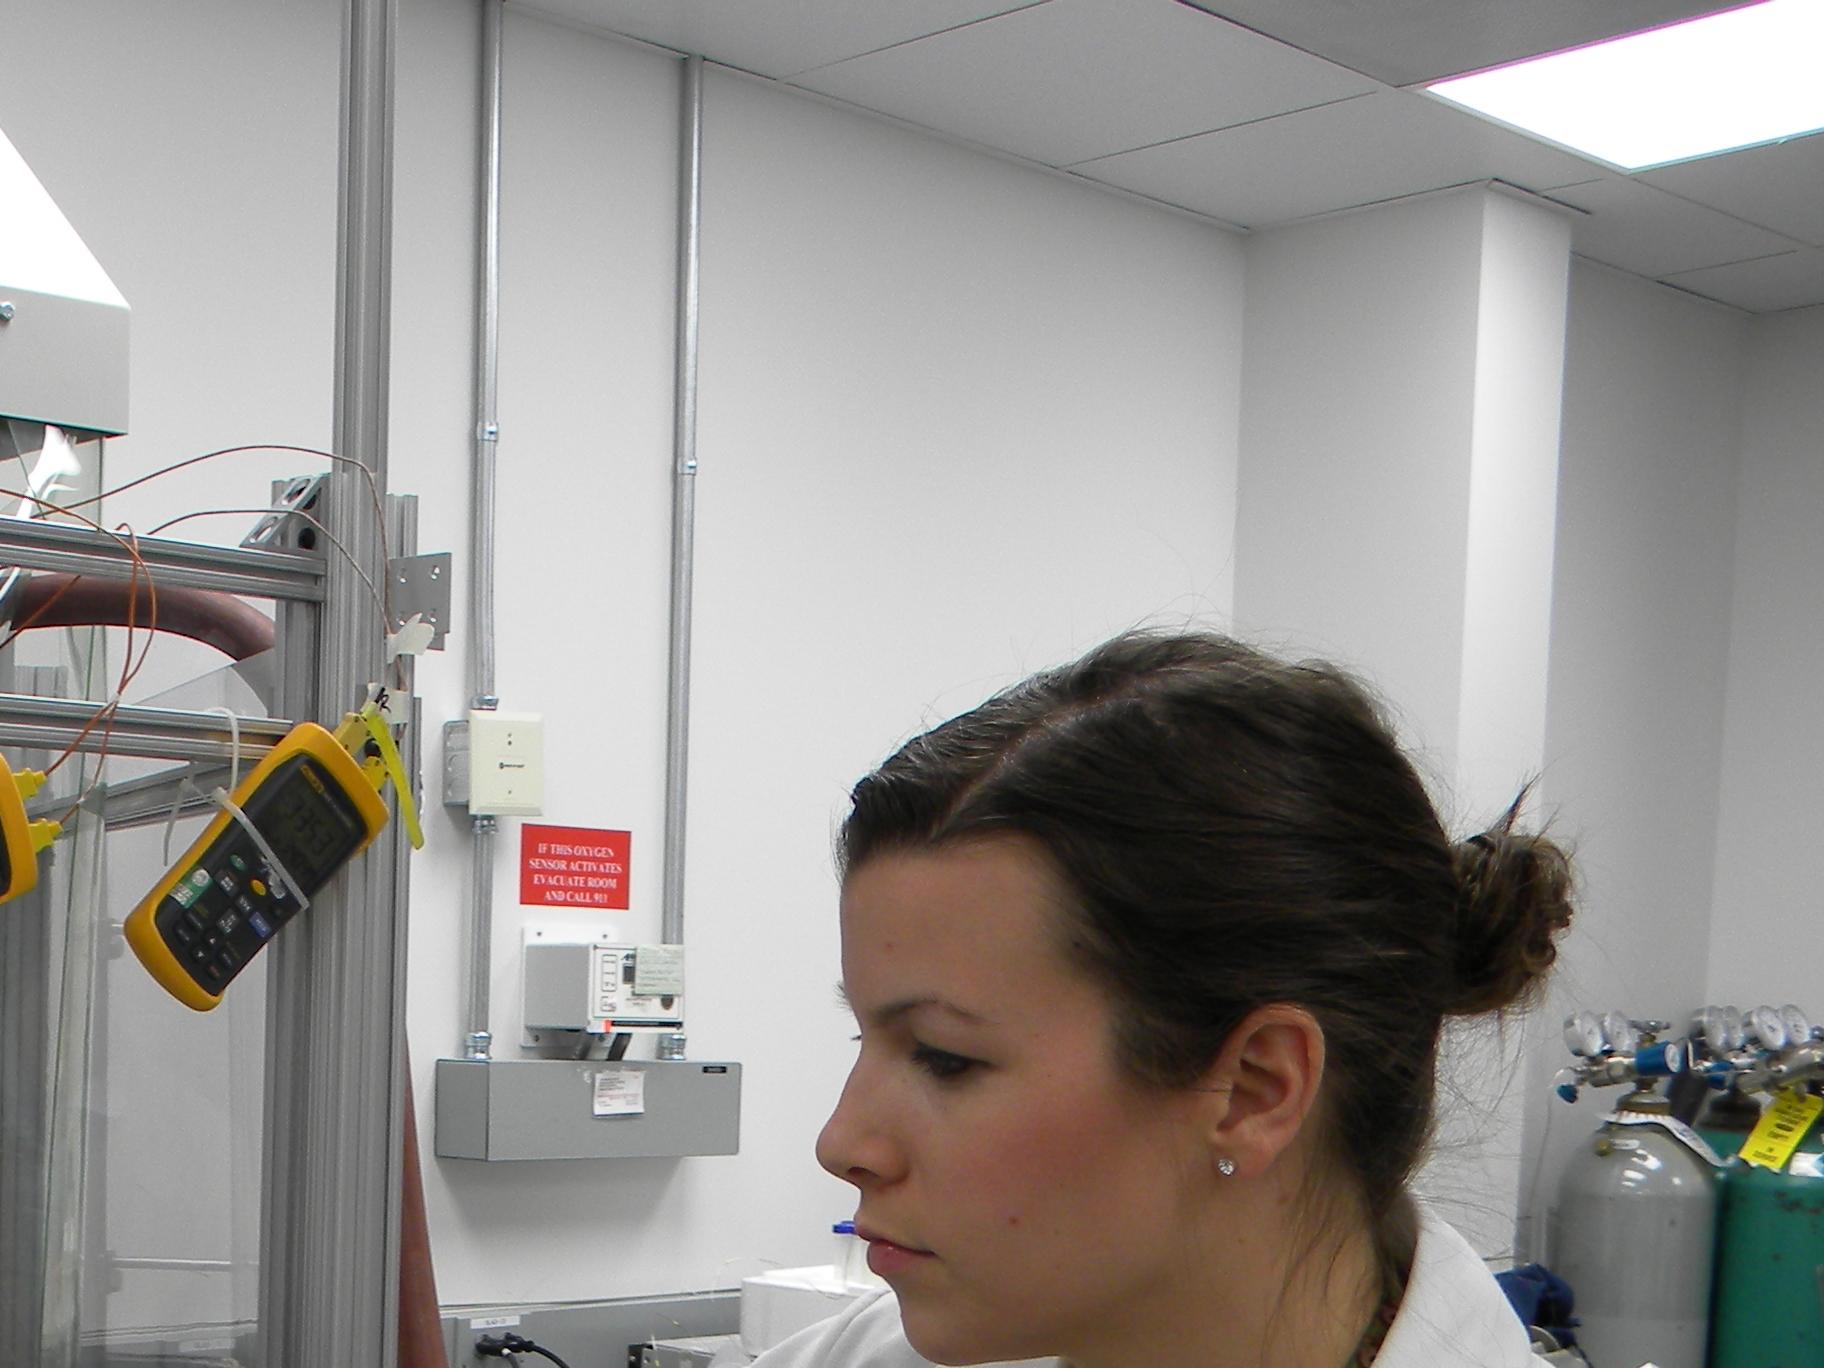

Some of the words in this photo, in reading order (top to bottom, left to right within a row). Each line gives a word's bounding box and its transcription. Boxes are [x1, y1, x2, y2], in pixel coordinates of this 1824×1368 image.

[538, 842, 548, 854] IF
[550, 843, 573, 856] THIS
[573, 845, 615, 858] OXYGEN
[528, 858, 568, 871] SENSOR
[568, 859, 623, 874] ACTIVATES
[533, 873, 587, 888] EVACUATE
[586, 877, 618, 889] ROOM
[544, 890, 565, 901] AND
[566, 890, 593, 903] CALL
